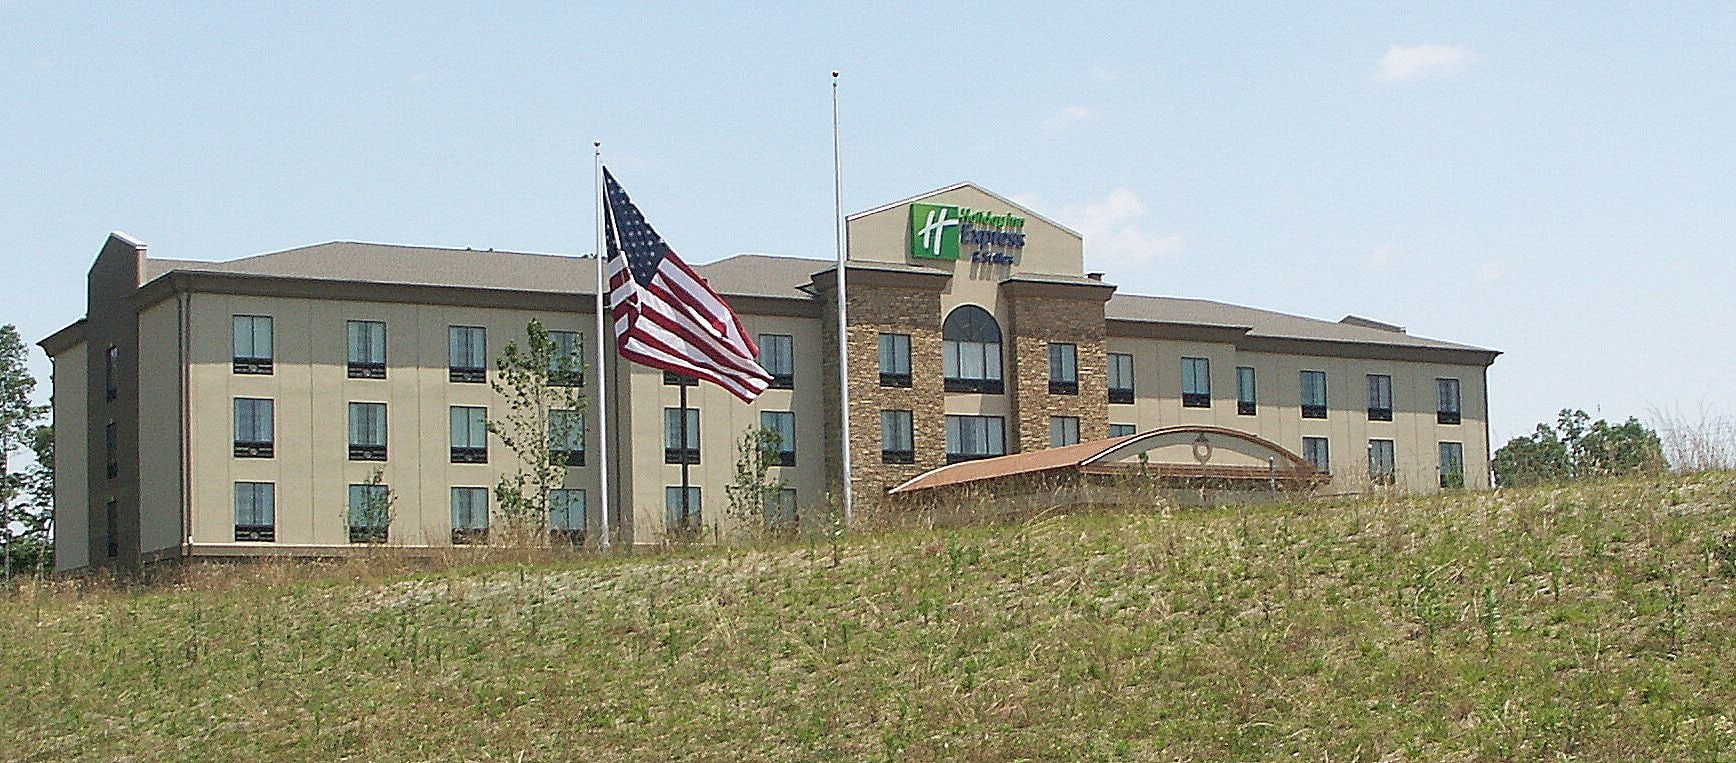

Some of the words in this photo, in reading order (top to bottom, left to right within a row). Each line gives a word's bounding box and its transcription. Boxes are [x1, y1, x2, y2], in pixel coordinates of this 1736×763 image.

[959, 208, 1005, 228] Holiday
[1005, 212, 1025, 228] Inn
[961, 223, 1026, 250] Express
[981, 251, 1013, 265] Suites
